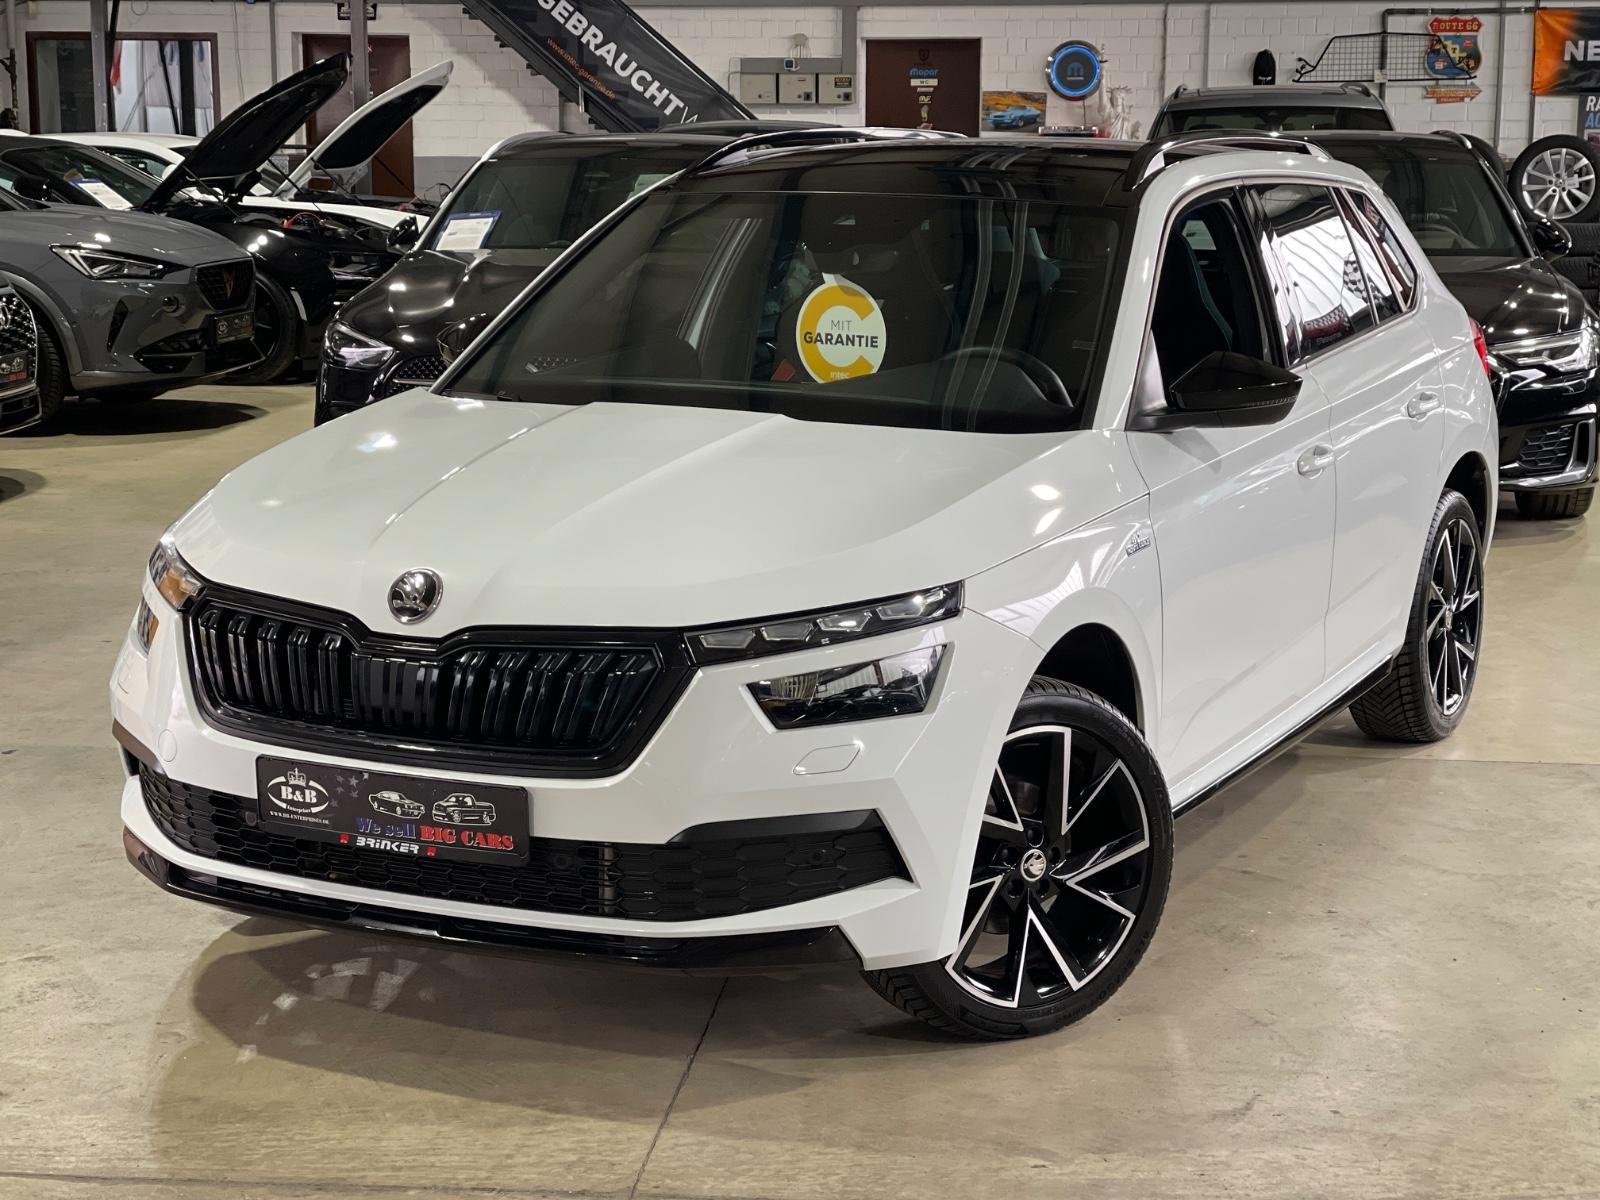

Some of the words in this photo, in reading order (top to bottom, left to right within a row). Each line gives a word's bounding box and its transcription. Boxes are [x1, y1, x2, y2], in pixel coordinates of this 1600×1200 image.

[1466, 21, 1479, 30] 66
[830, 319, 853, 331] MIT
[803, 331, 879, 348] GARANTIE
[280, 785, 317, 803] B&B
[355, 817, 382, 834] We
[385, 823, 417, 840] sell
[420, 825, 456, 844] BIG
[460, 830, 514, 851] CARS
